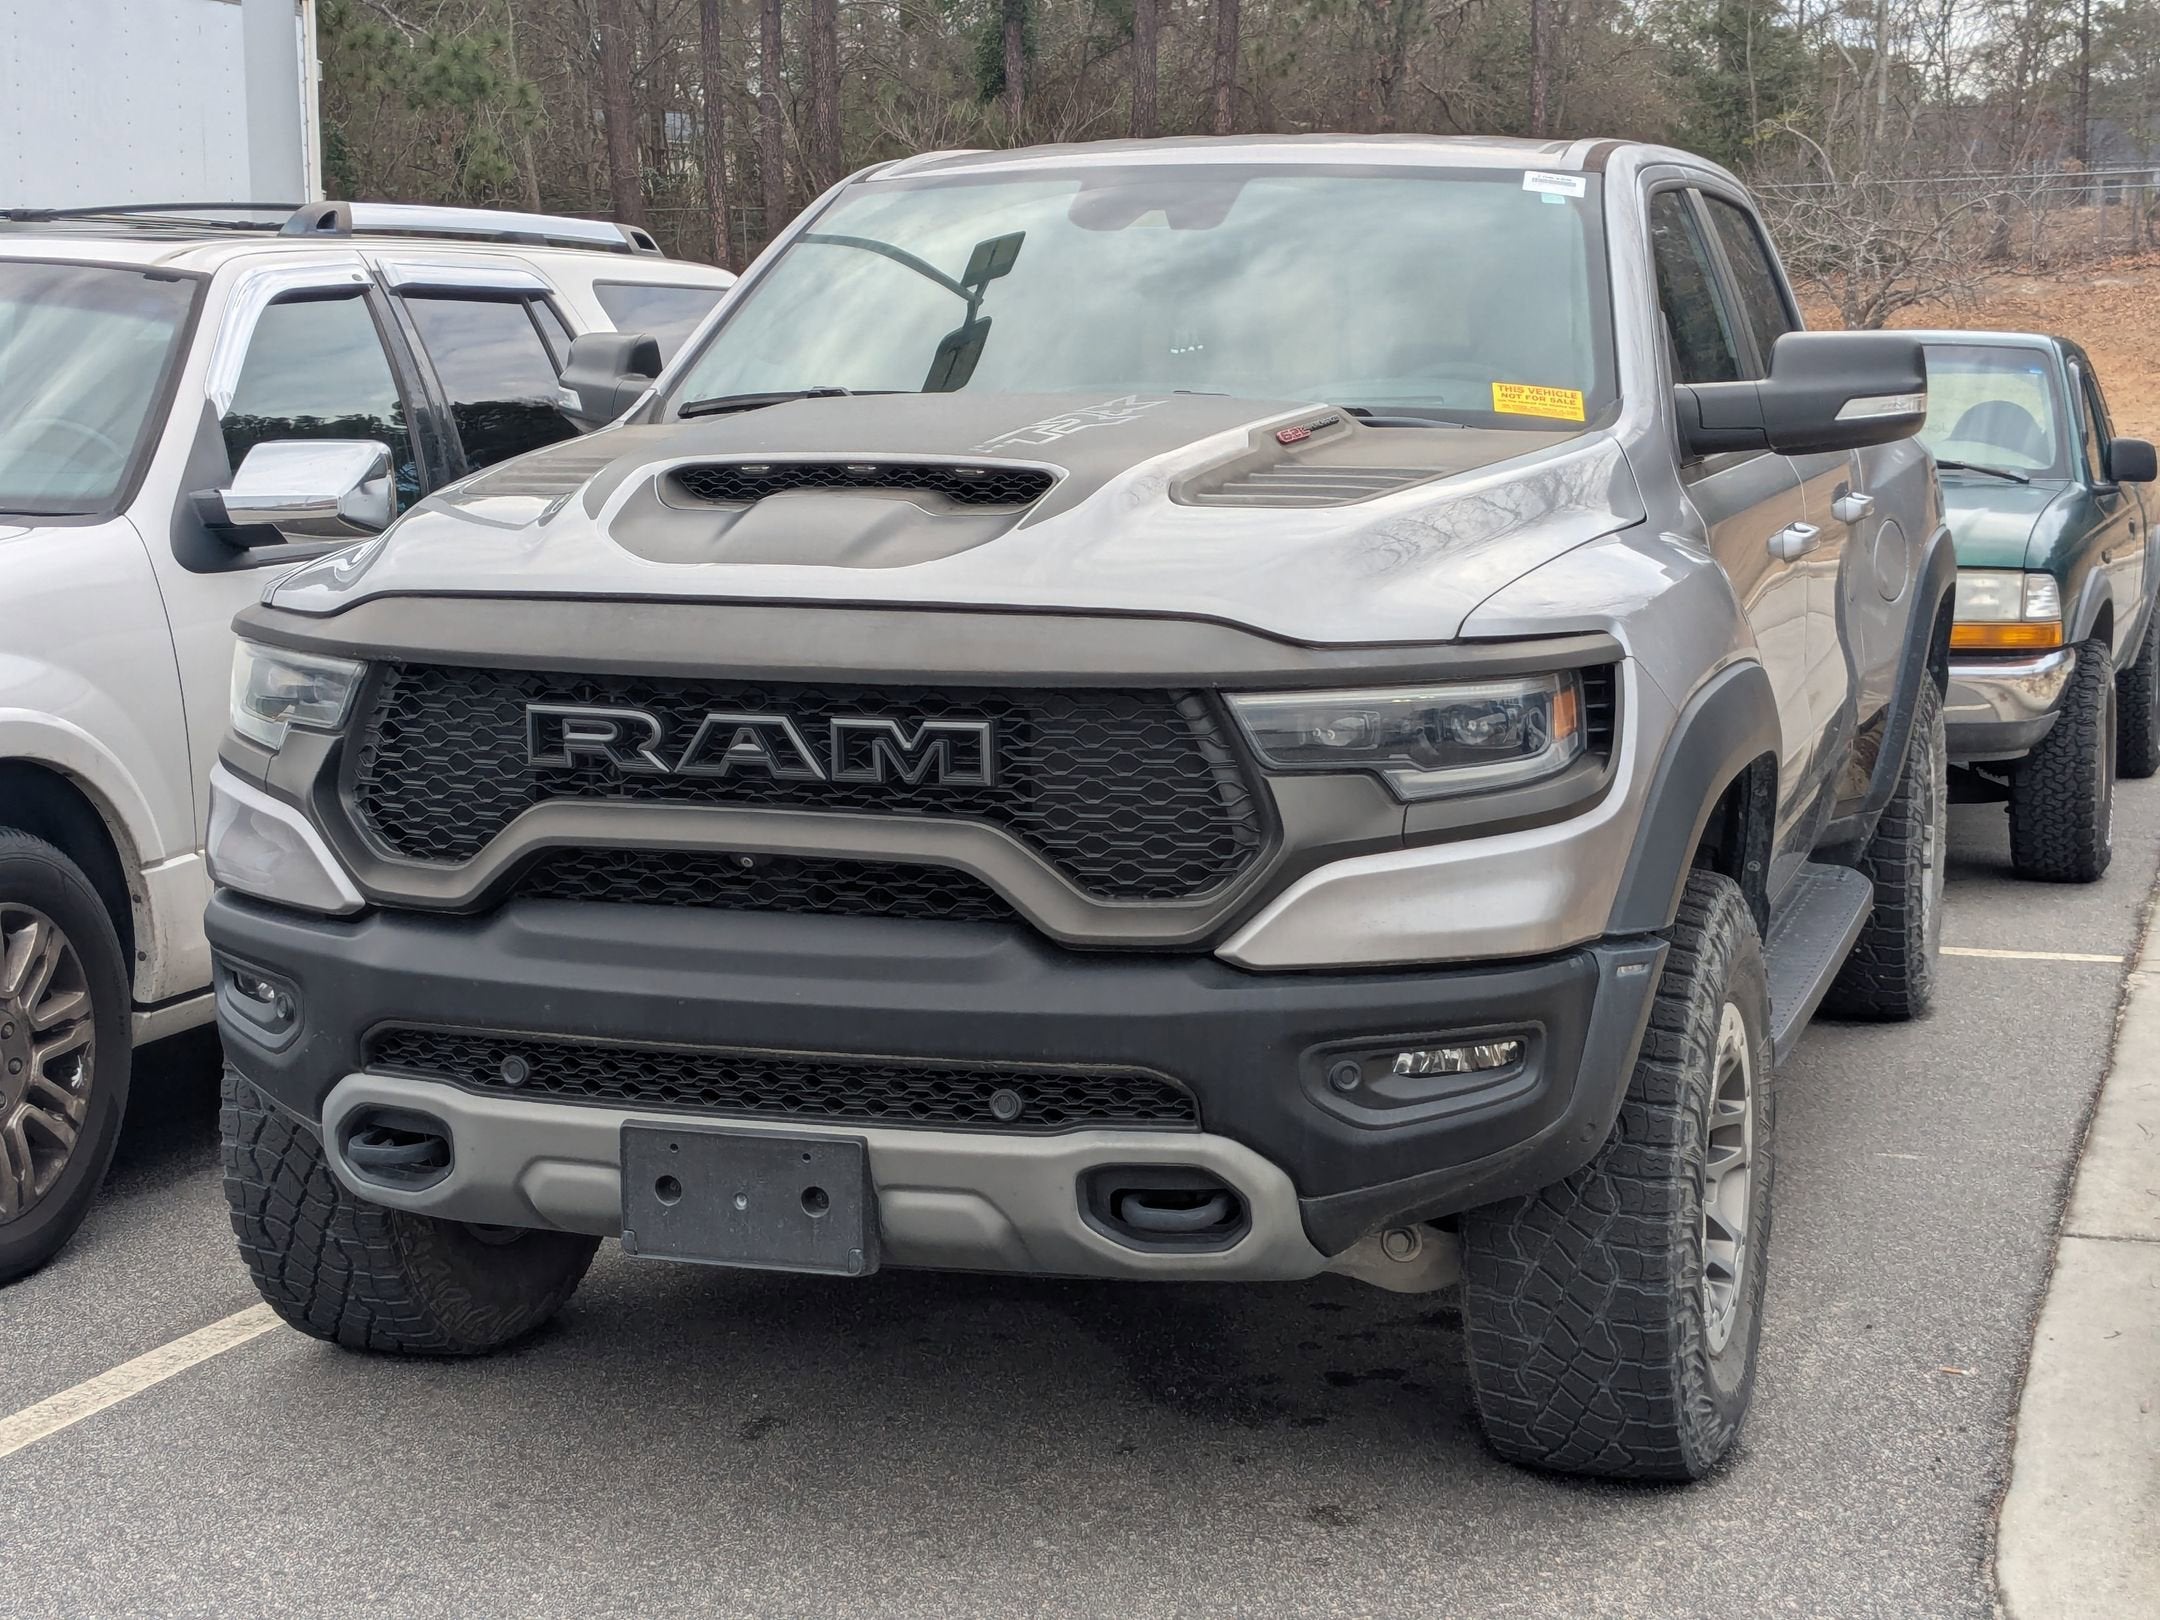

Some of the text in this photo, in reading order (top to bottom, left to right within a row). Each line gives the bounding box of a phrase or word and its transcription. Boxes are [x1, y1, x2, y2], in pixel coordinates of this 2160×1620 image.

[1498, 384, 1577, 400] THIS VEHICLE
[1501, 392, 1521, 400] NOT
[1525, 394, 1546, 403] FOR
[1550, 397, 1577, 406] SALE
[525, 702, 996, 787] RAM
